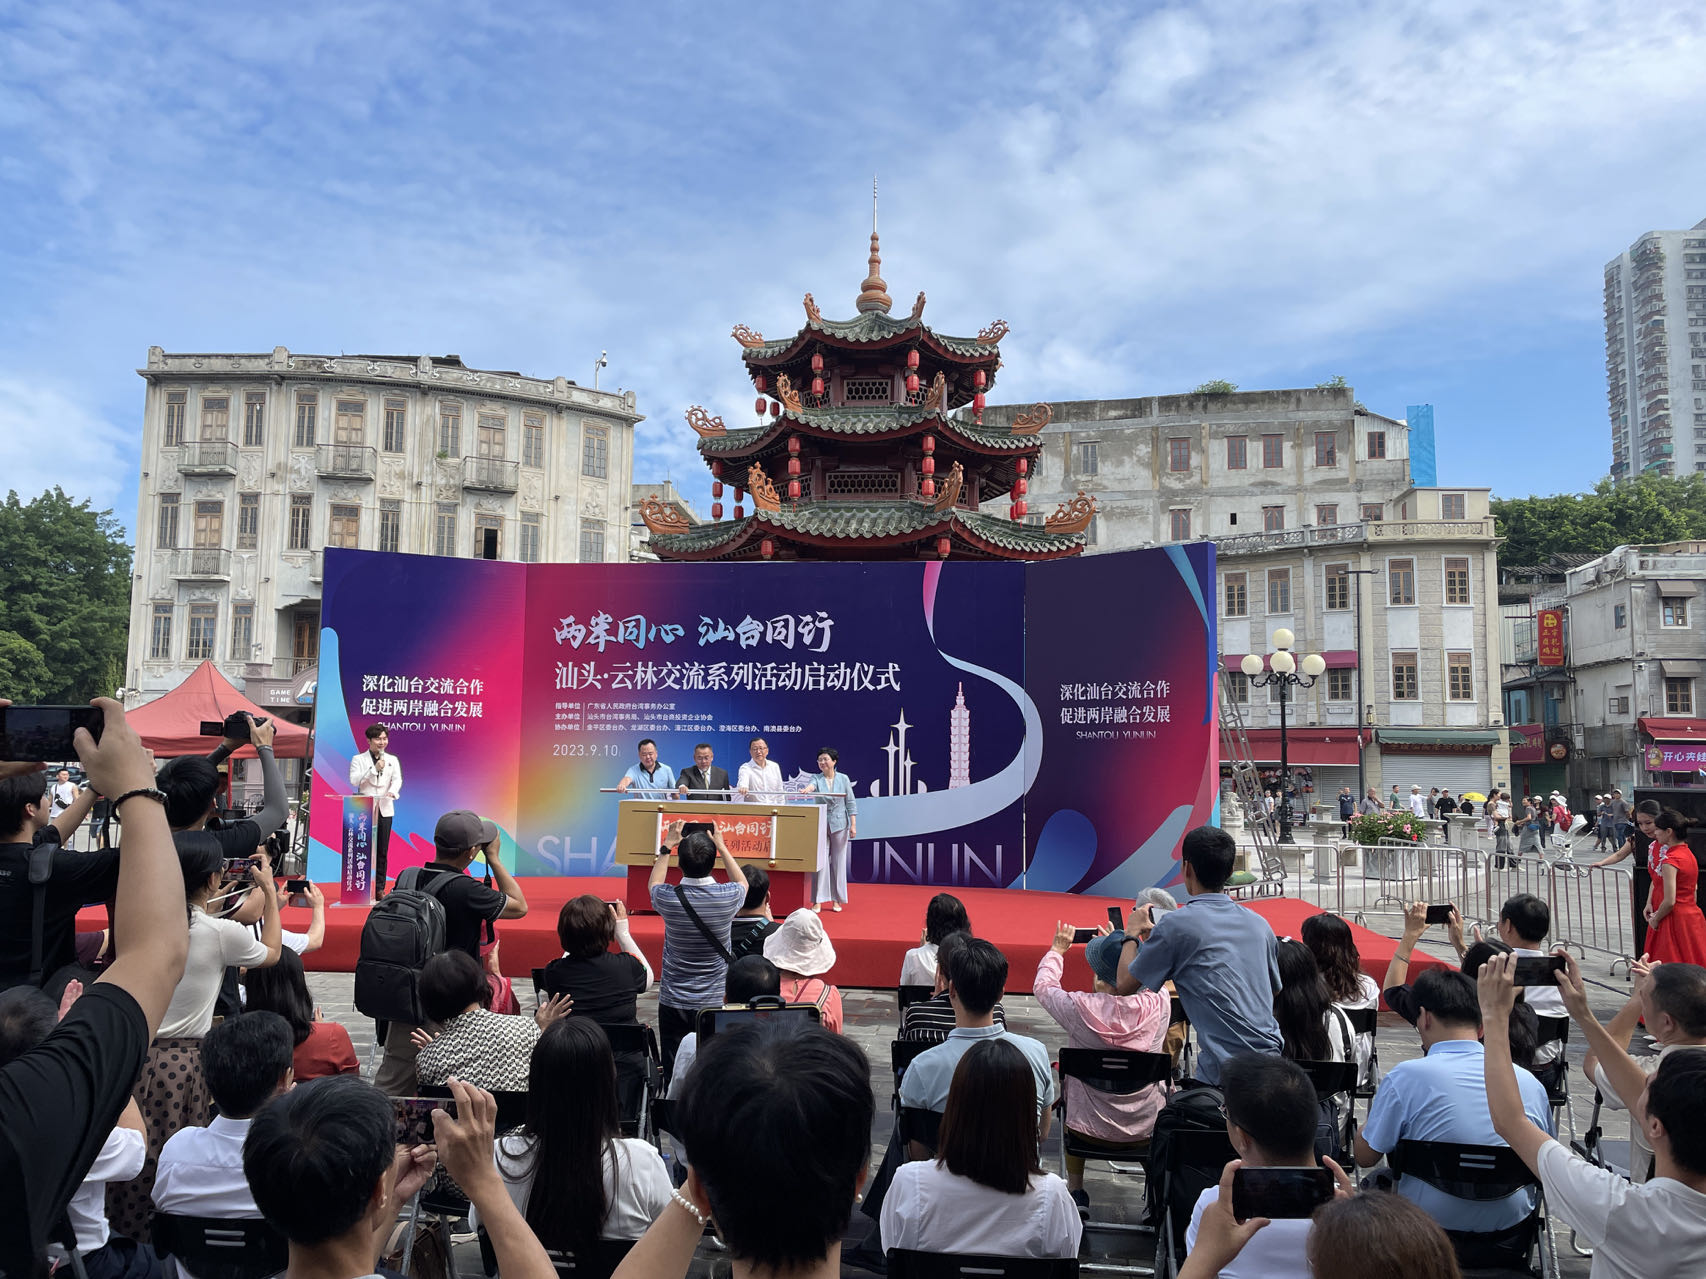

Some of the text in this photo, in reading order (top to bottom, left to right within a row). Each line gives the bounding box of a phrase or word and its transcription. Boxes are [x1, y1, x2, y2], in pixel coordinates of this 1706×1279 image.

[553, 610, 834, 653] 两岸同心 汕台同行
[362, 674, 484, 695] 深化汕台交流合作
[555, 661, 901, 691] 汕头·云林交流系列活动启动仪式
[1060, 680, 1171, 701] 深化汕台交流合作
[361, 698, 483, 718] 促进两岸融合发展
[1060, 705, 1171, 724] 促进两岸融合发展
[553, 744, 618, 756] 2023.9.10
[847, 840, 1003, 888] UNLIN
